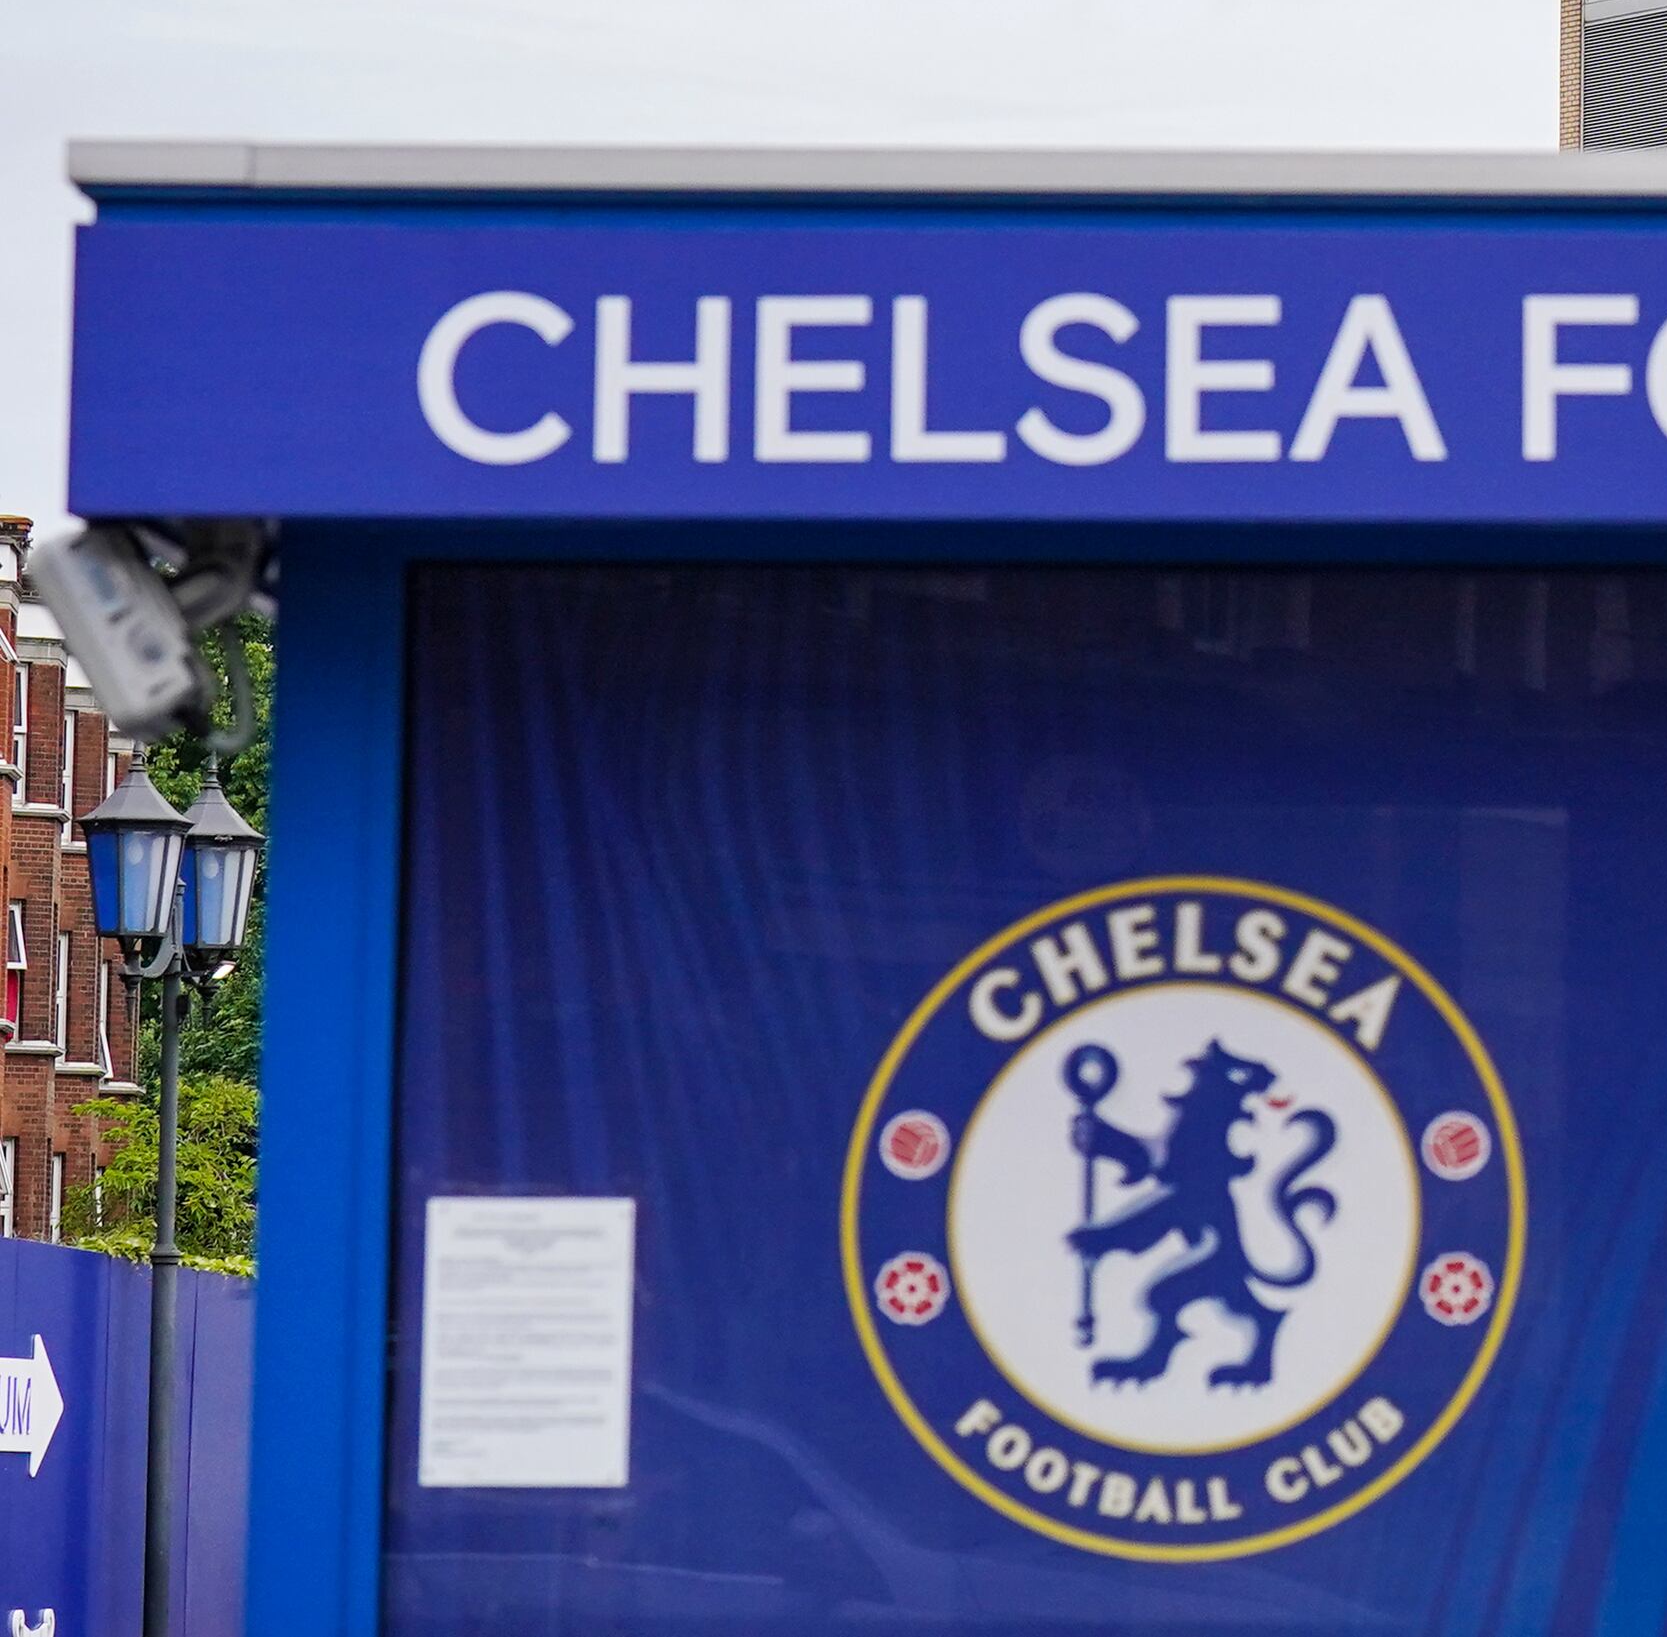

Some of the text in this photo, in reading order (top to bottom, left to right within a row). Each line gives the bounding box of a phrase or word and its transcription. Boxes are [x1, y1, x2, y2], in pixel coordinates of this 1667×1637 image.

[416, 290, 1448, 468] CHELSEA
[966, 902, 1404, 1054] CHELSEA
[0, 1375, 32, 1435] UM
[955, 1396, 1406, 1525] FOOTBALL CLUB
